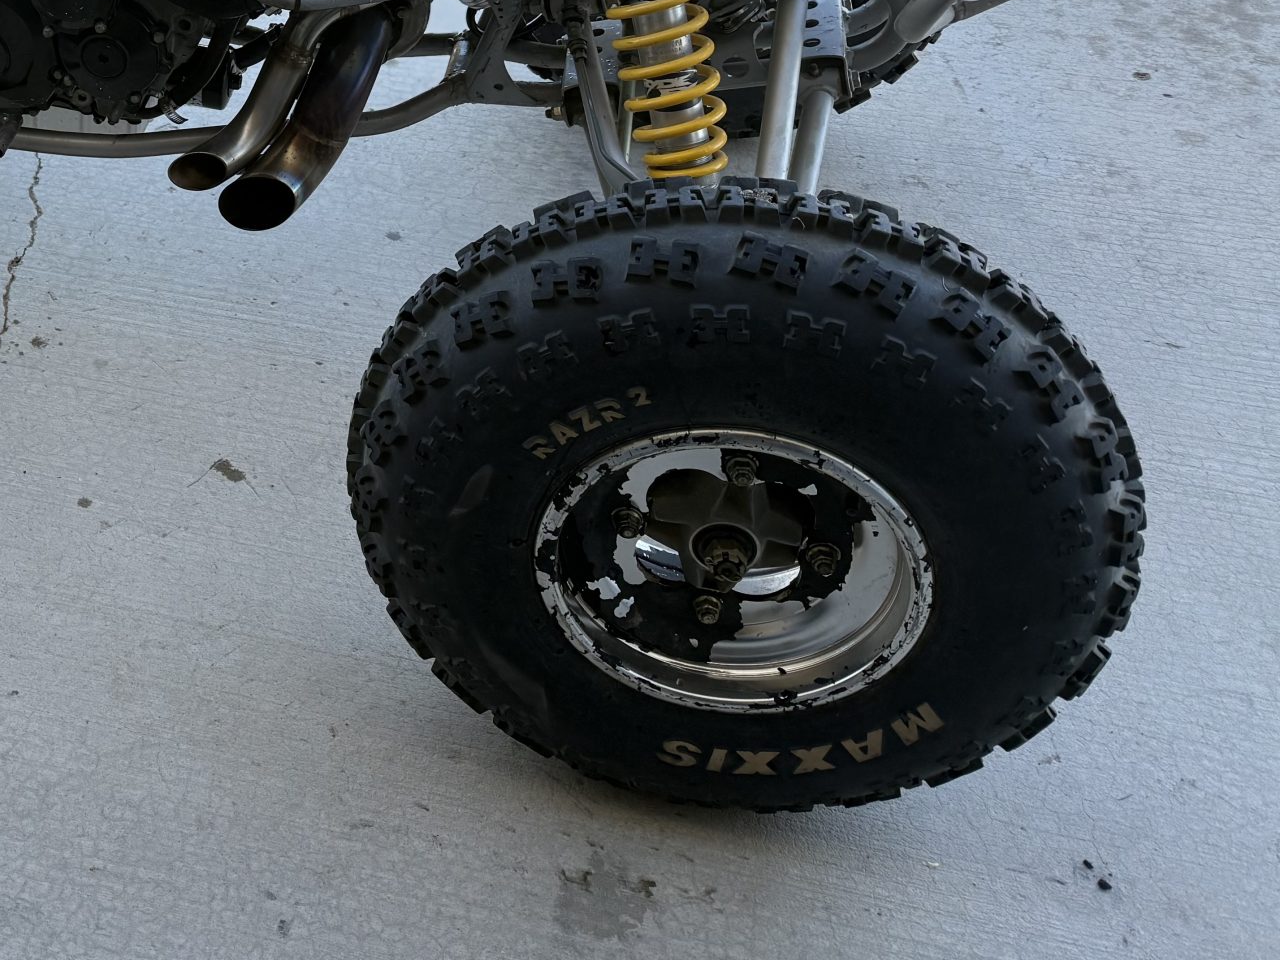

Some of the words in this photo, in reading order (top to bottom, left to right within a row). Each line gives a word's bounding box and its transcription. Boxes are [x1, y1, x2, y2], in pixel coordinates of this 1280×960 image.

[521, 398, 626, 460] RAZR
[626, 386, 653, 407] 2
[655, 702, 945, 776] MAXXIS
